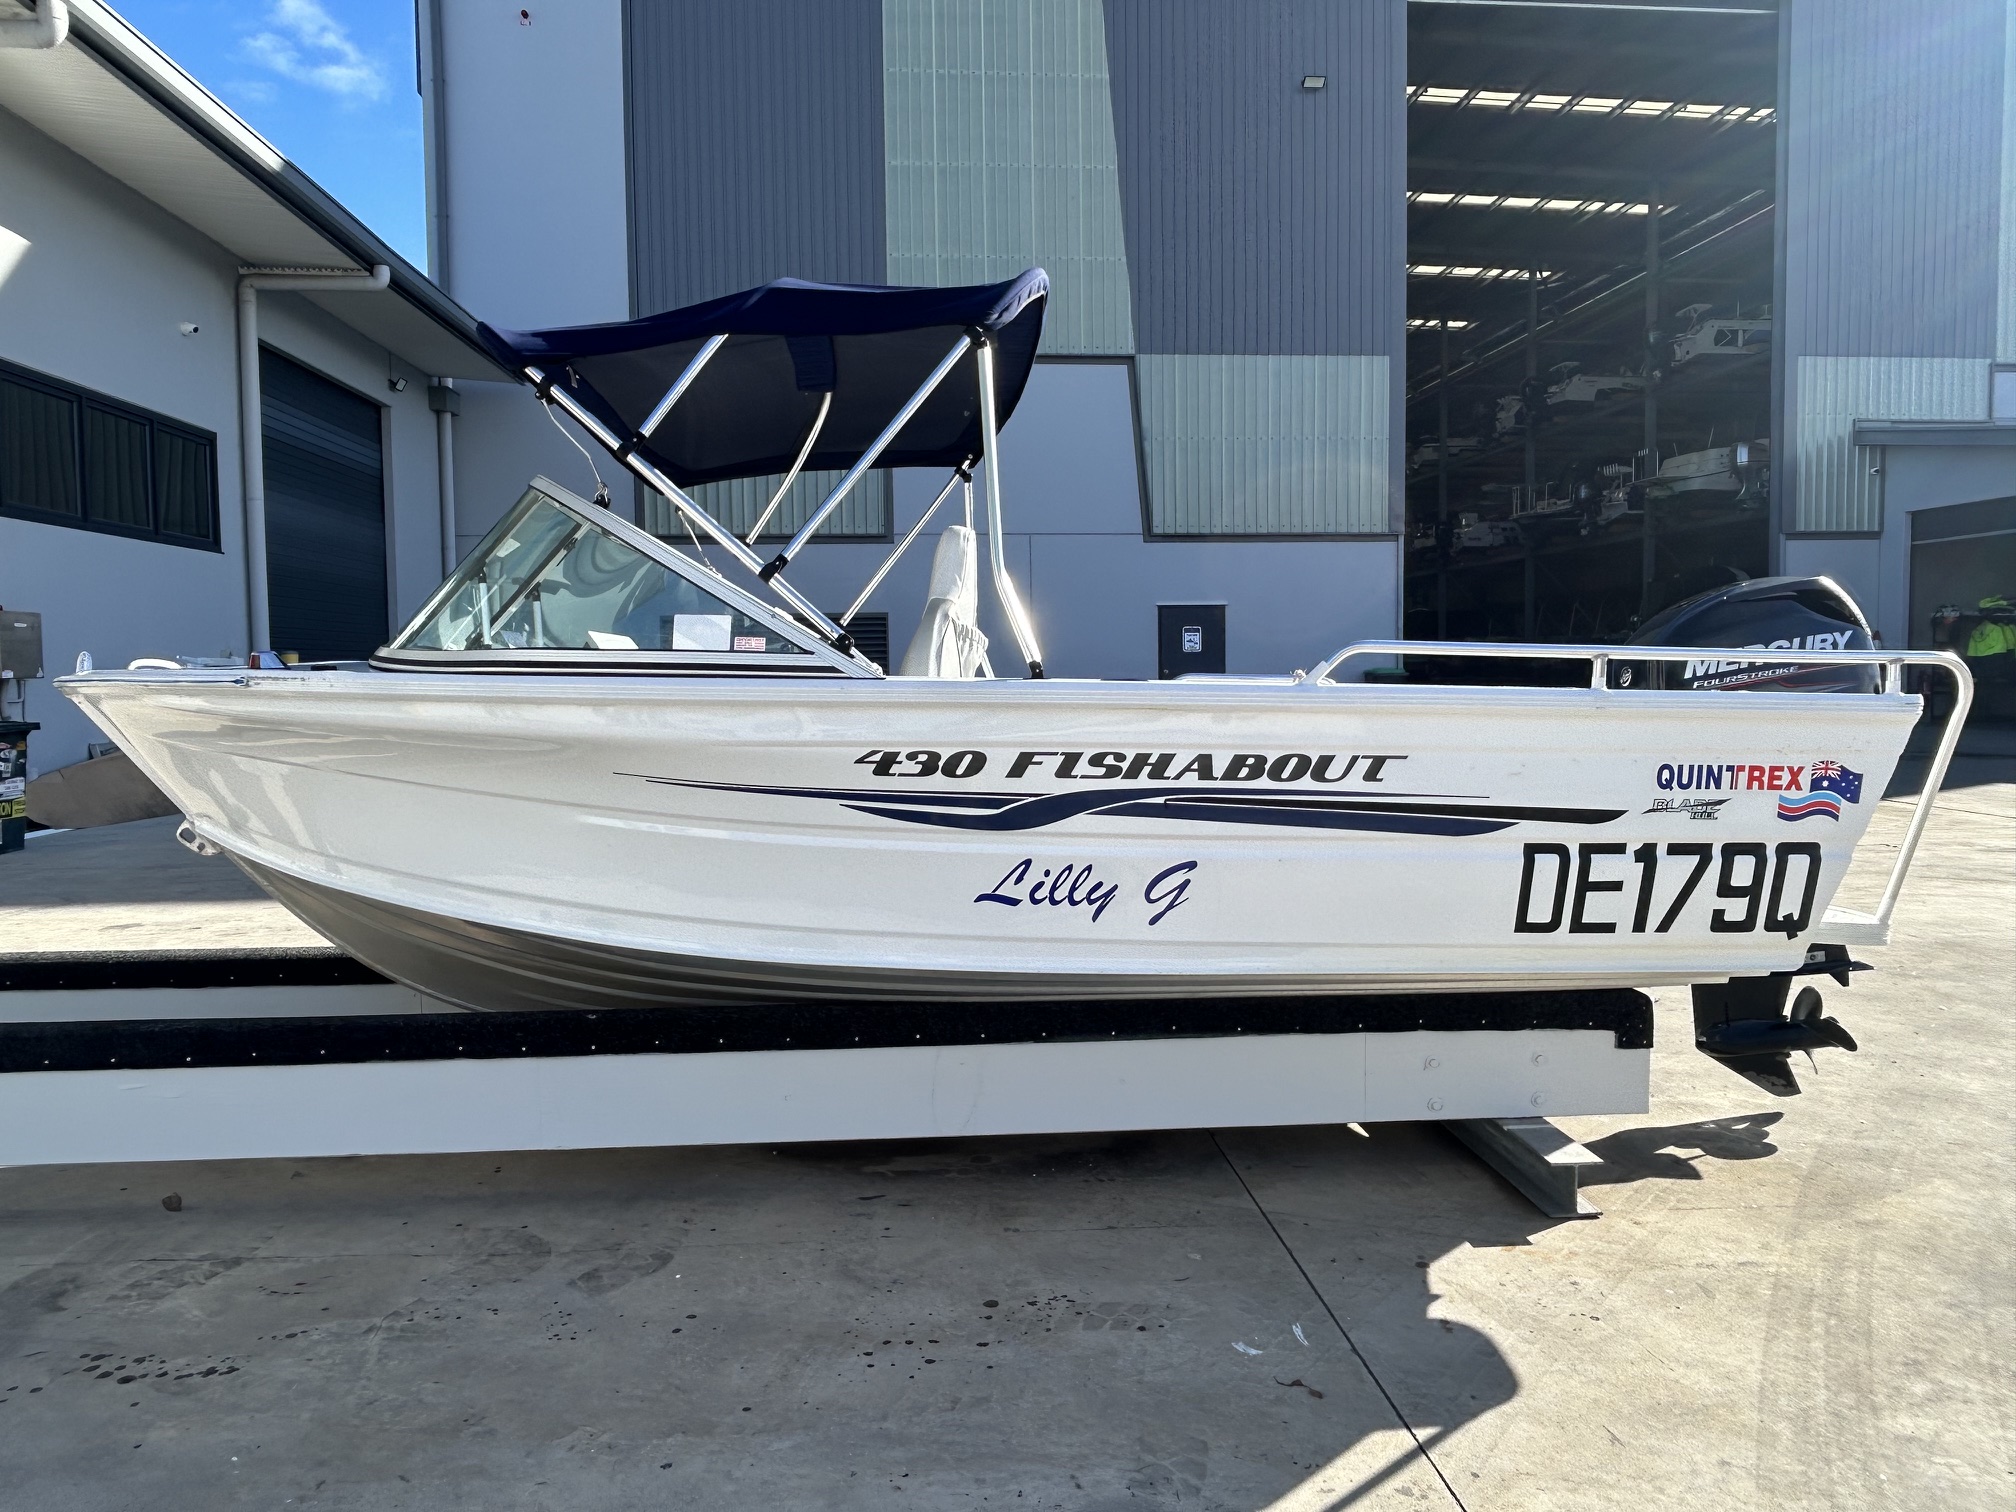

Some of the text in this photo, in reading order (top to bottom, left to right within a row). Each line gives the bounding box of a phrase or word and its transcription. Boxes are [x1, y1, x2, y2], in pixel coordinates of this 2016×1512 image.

[1693, 665, 1799, 689] FOURSTROKE
[854, 749, 1409, 783] 430 FISHABOUT
[1656, 763, 1806, 792] QUINTREX
[973, 858, 1199, 926] Lilly G
[1513, 842, 1822, 940] DE179Q
